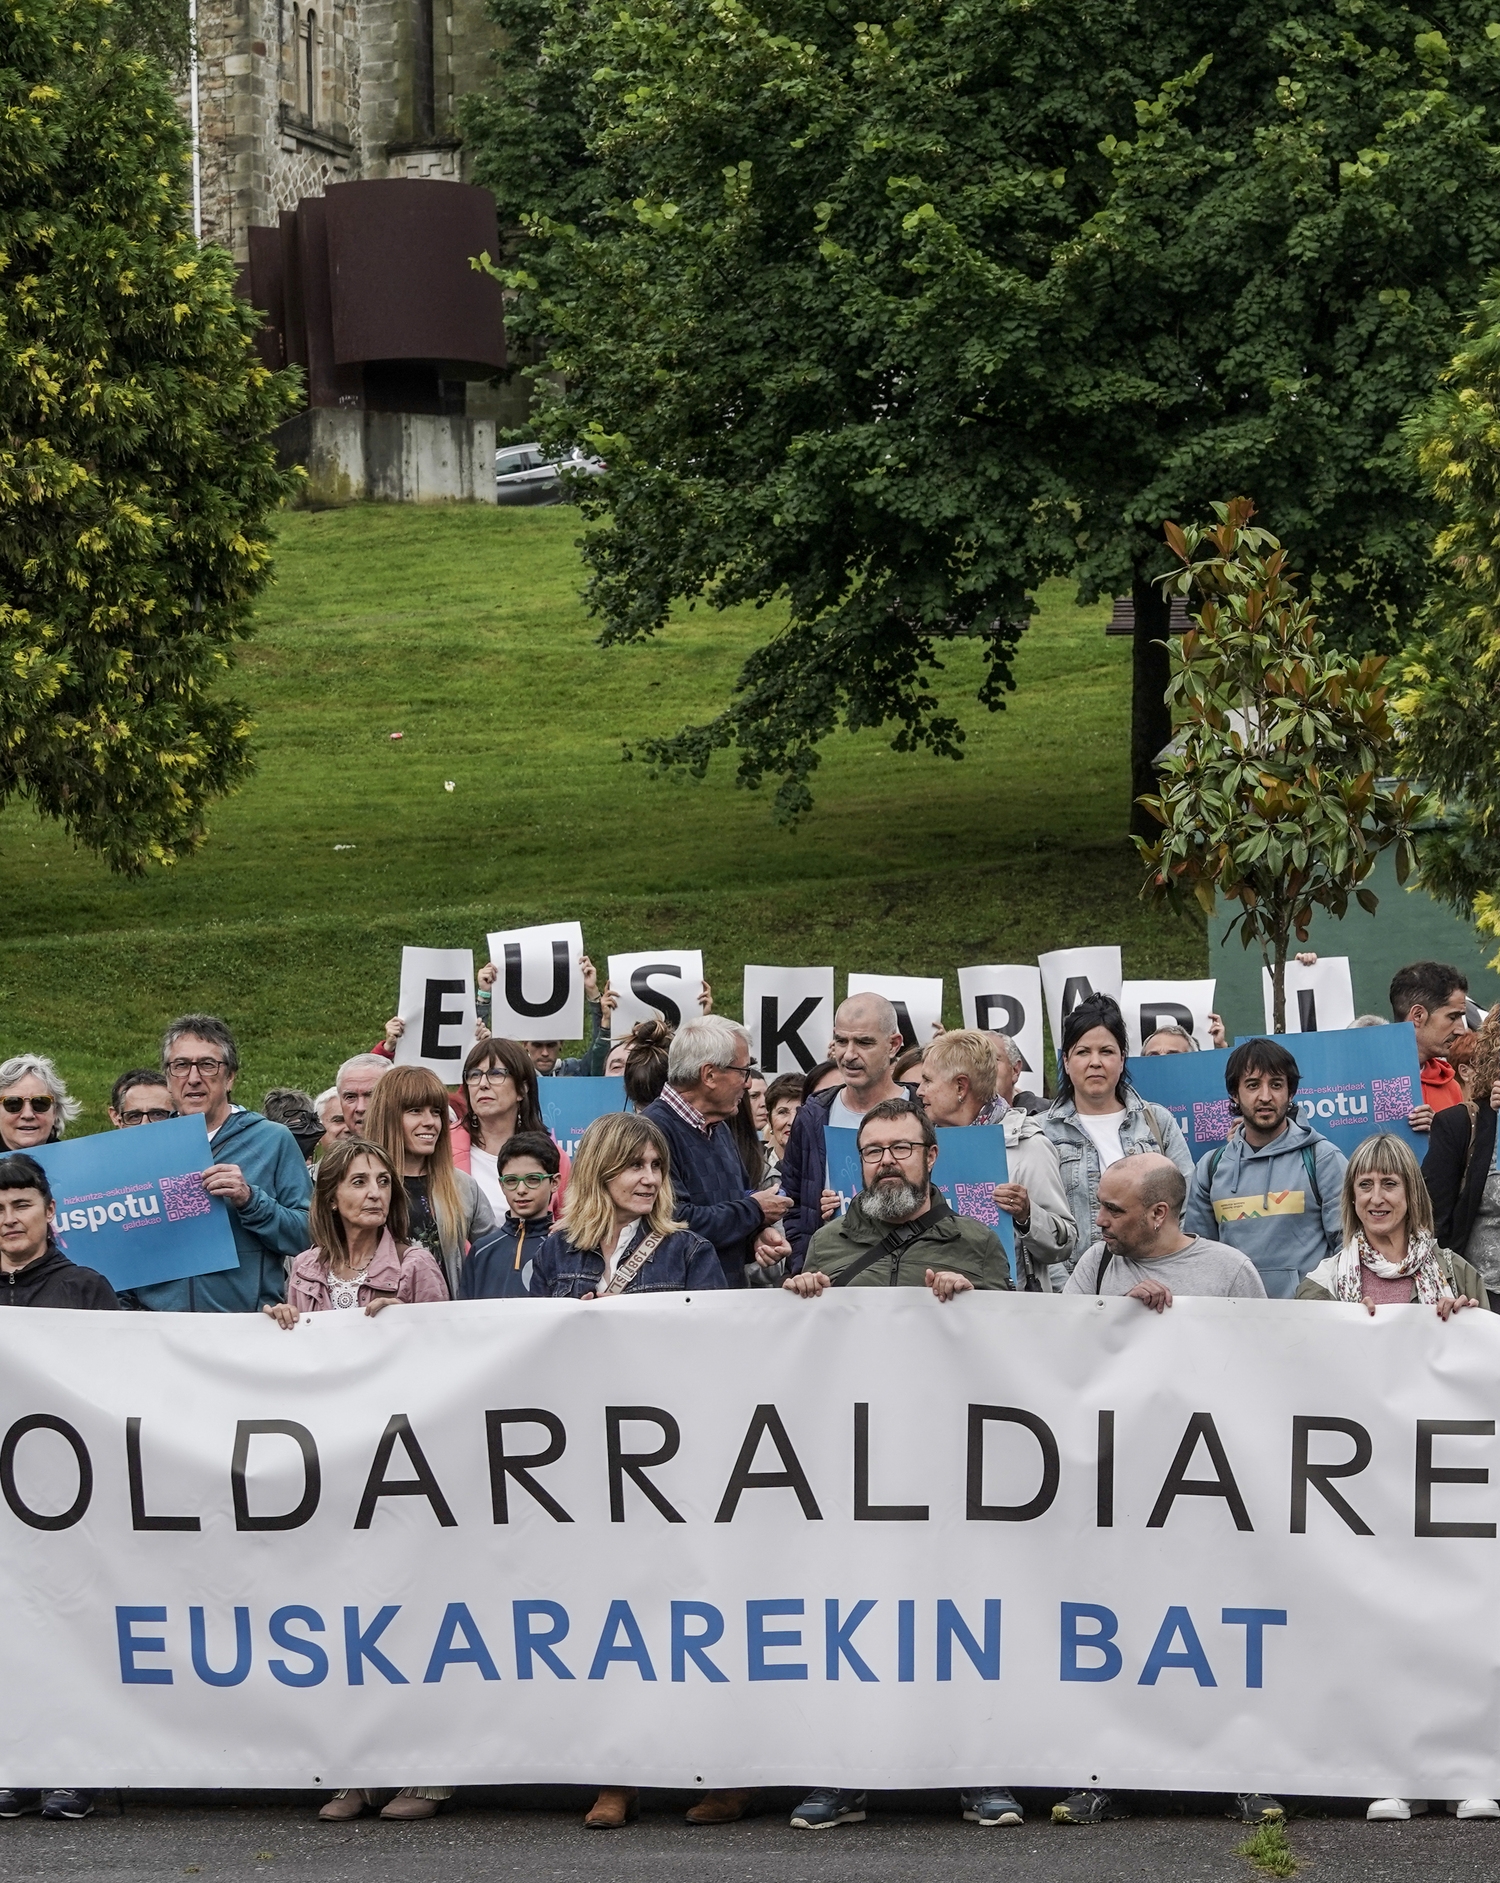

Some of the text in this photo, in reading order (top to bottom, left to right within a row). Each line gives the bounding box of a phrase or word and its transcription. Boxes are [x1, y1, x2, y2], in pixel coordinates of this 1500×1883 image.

[504, 941, 570, 1018] U
[630, 964, 682, 1030] S
[420, 978, 466, 1060] E
[760, 995, 824, 1074] K
[974, 993, 1033, 1073] R
[1296, 1083, 1366, 1096] ntza-eskubideak
[1300, 1092, 1368, 1118] potu
[1329, 1116, 1369, 1128] galdakao
[53, 1194, 160, 1233] uspotu
[63, 1181, 154, 1206] hizkuntza-eskubideak
[122, 1216, 162, 1232] galdakao
[116, 1598, 1001, 1687] EUSKARAREKIN
[1060, 1601, 1287, 1688] BAT
